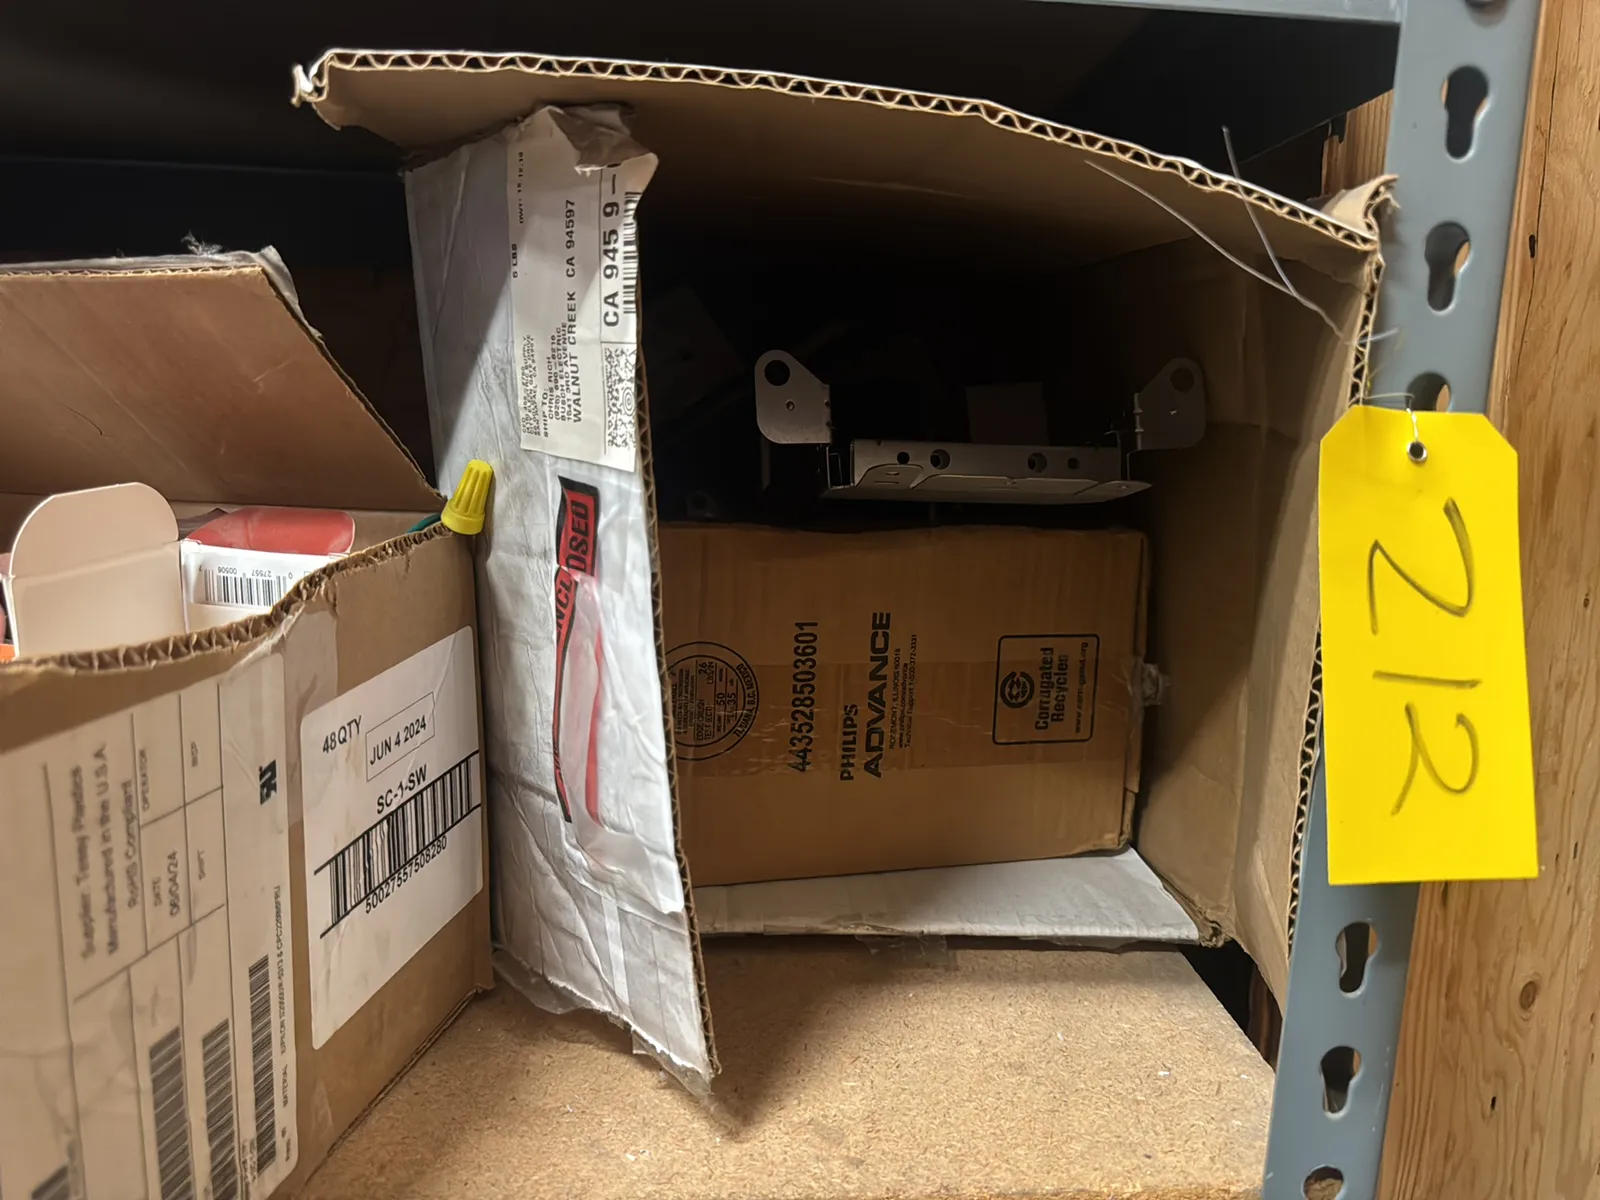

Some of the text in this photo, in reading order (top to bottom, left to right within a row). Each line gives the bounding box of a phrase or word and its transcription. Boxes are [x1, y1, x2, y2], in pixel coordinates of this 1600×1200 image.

[510, 243, 518, 266] LBS
[602, 228, 620, 279] 945
[565, 198, 582, 423] WALNUT CREEK CA 94597
[603, 290, 620, 327] CA
[546, 356, 554, 382] RICH
[561, 322, 569, 367] AVENUE
[555, 326, 567, 421] BUSCH ELECTRIC
[541, 388, 550, 437] SHIP TO:
[251, 570, 272, 578] 27557
[697, 661, 707, 674] 26
[705, 660, 715, 684] LBS/IN
[735, 662, 754, 689] MEXICO
[1034, 646, 1055, 730] Corrugated
[695, 699, 706, 740] EDGE CRUSH
[716, 692, 726, 705] 50
[726, 692, 737, 705] 35
[787, 620, 819, 772] 443528503601
[863, 612, 891, 778] ADVANCE
[369, 714, 427, 766] JUN 4 2024
[704, 725, 713, 740] TEST
[839, 703, 859, 781] PHILIPS
[70, 766, 85, 832] Plastics
[98, 799, 111, 827] the
[376, 763, 428, 815] SC-1-SW
[120, 779, 138, 860] Compliant
[364, 834, 448, 914] 50027557508280
[101, 847, 118, 956] Manufactured
